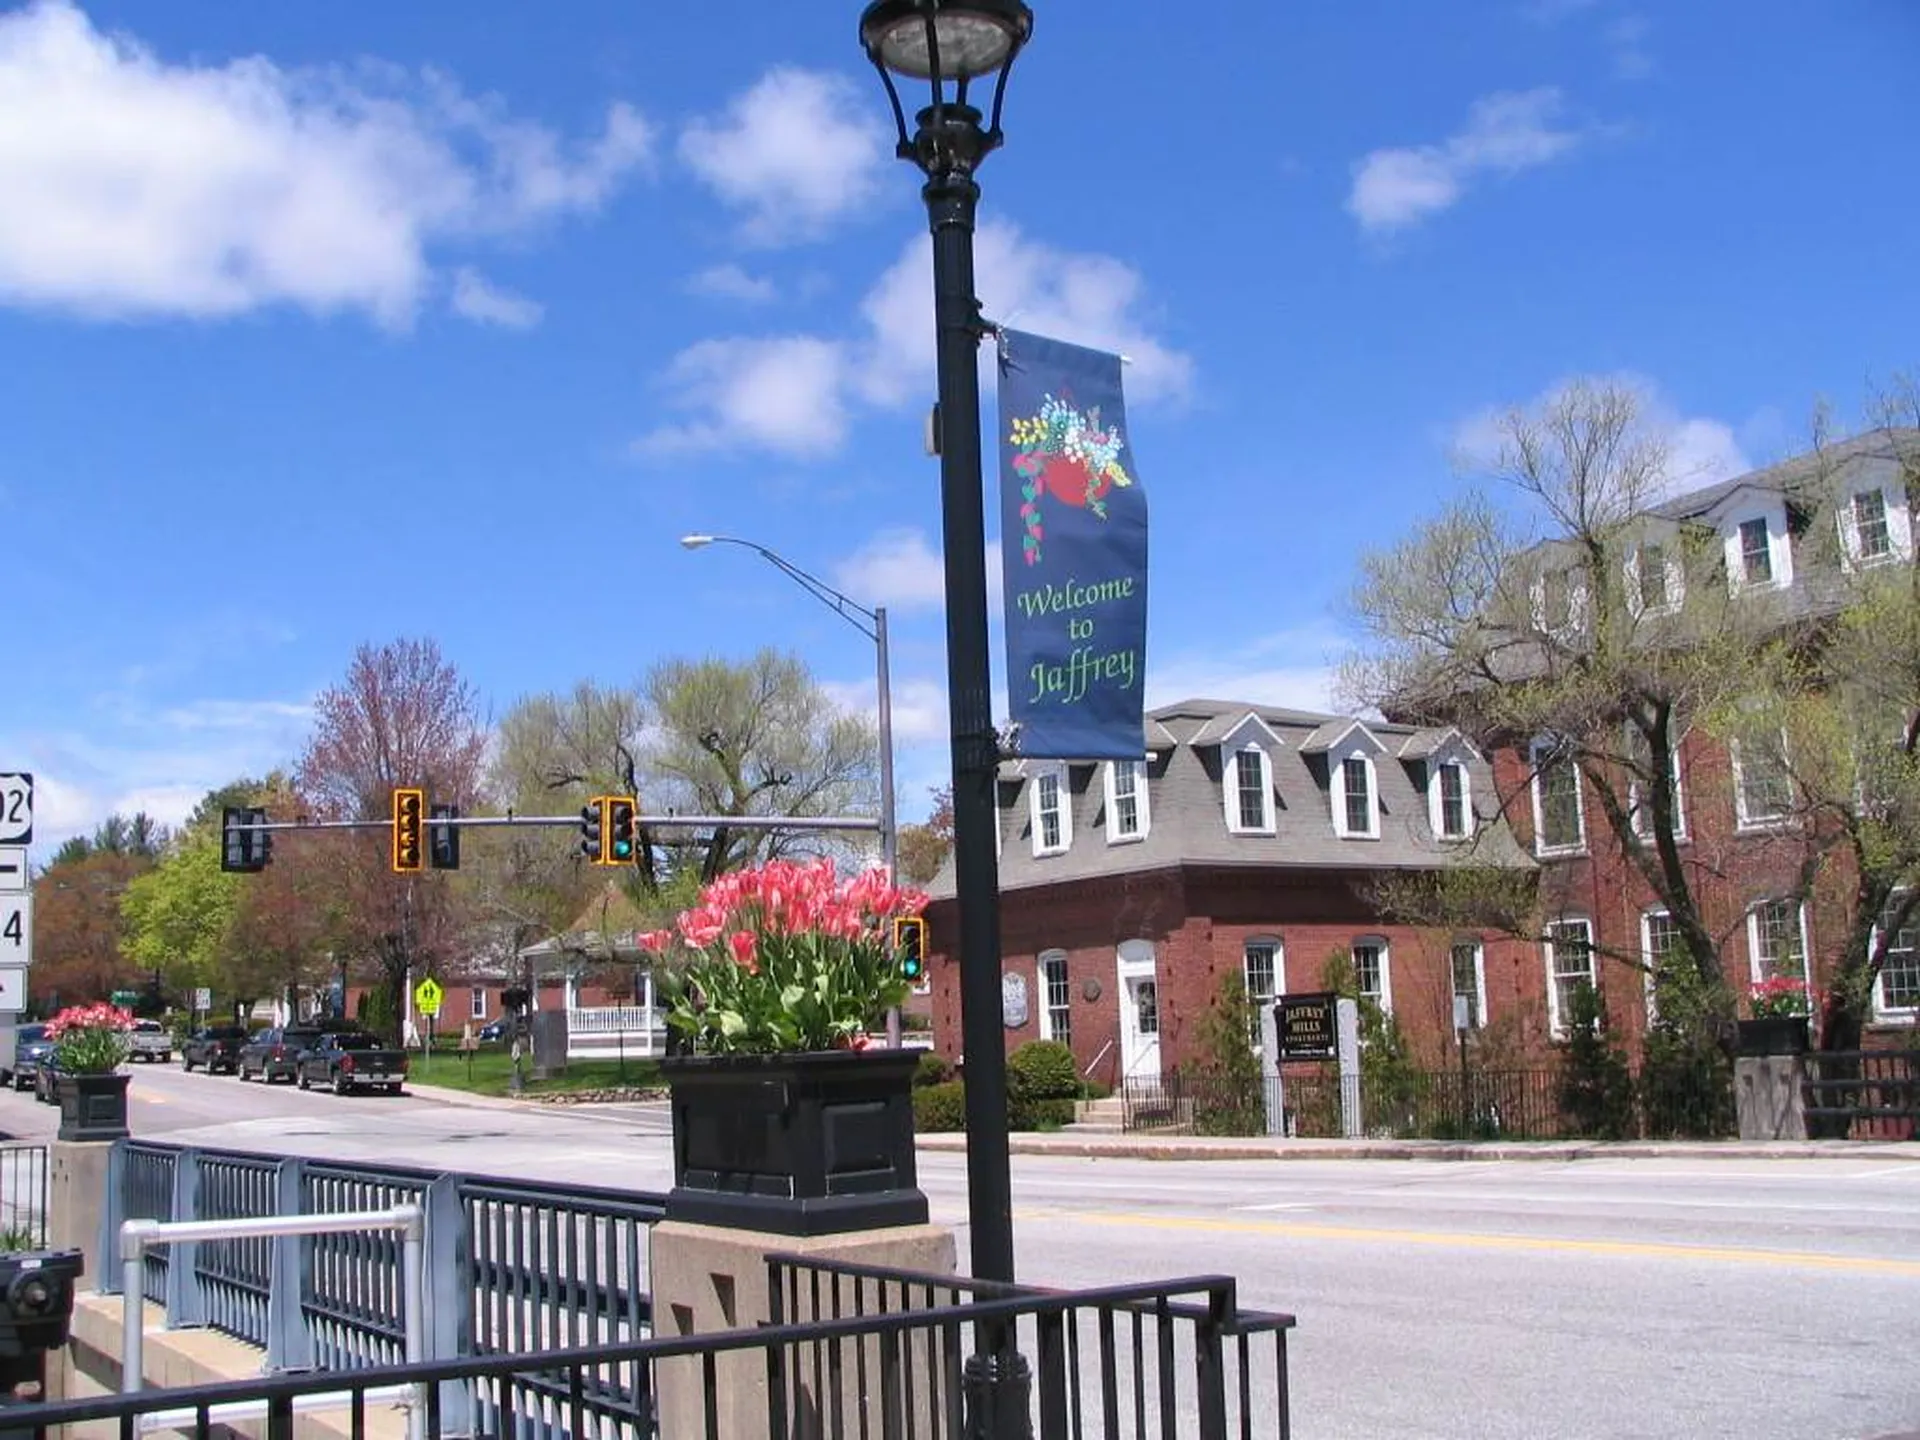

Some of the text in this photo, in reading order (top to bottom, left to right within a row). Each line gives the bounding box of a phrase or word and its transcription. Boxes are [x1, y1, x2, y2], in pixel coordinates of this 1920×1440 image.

[1017, 577, 1134, 618] Welcome
[1068, 618, 1093, 640] to
[1029, 645, 1134, 703] Jaffrey
